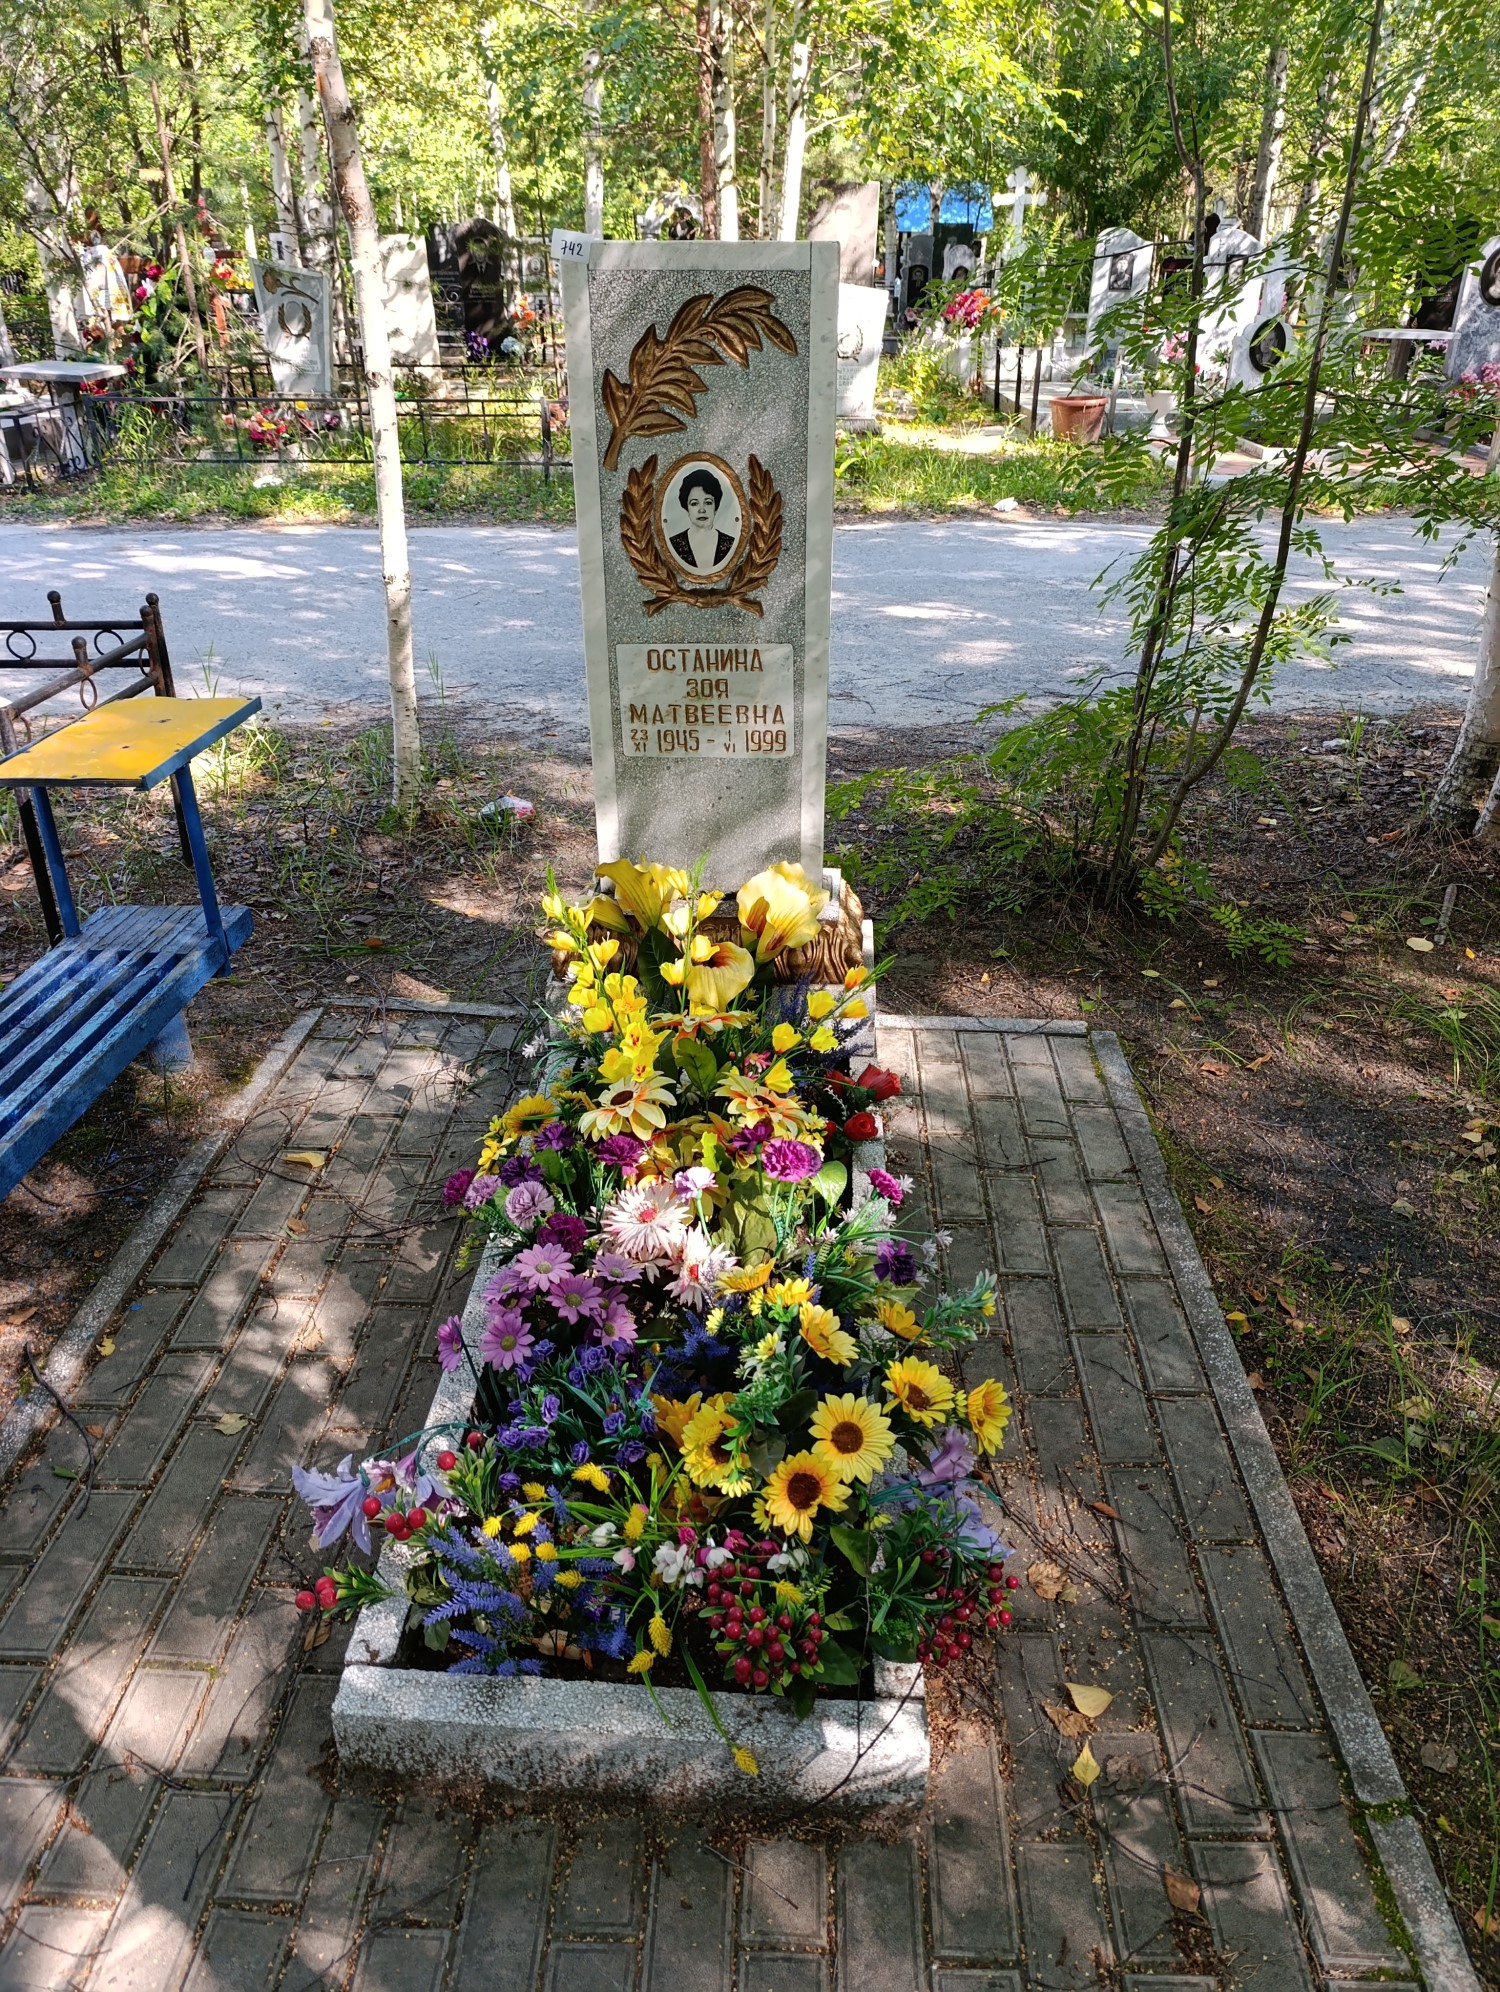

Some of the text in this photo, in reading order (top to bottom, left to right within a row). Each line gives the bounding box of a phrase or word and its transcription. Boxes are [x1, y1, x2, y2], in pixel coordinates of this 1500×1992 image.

[561, 240, 583, 256] 742
[647, 649, 763, 672] ОСТАНИНА
[686, 678, 729, 698] ЗОЯ
[629, 703, 785, 725] МАТВЕЕВНА
[630, 729, 648, 740] 23
[656, 729, 700, 753] 1945
[724, 743, 736, 752] VI
[745, 729, 787, 753] 1999
